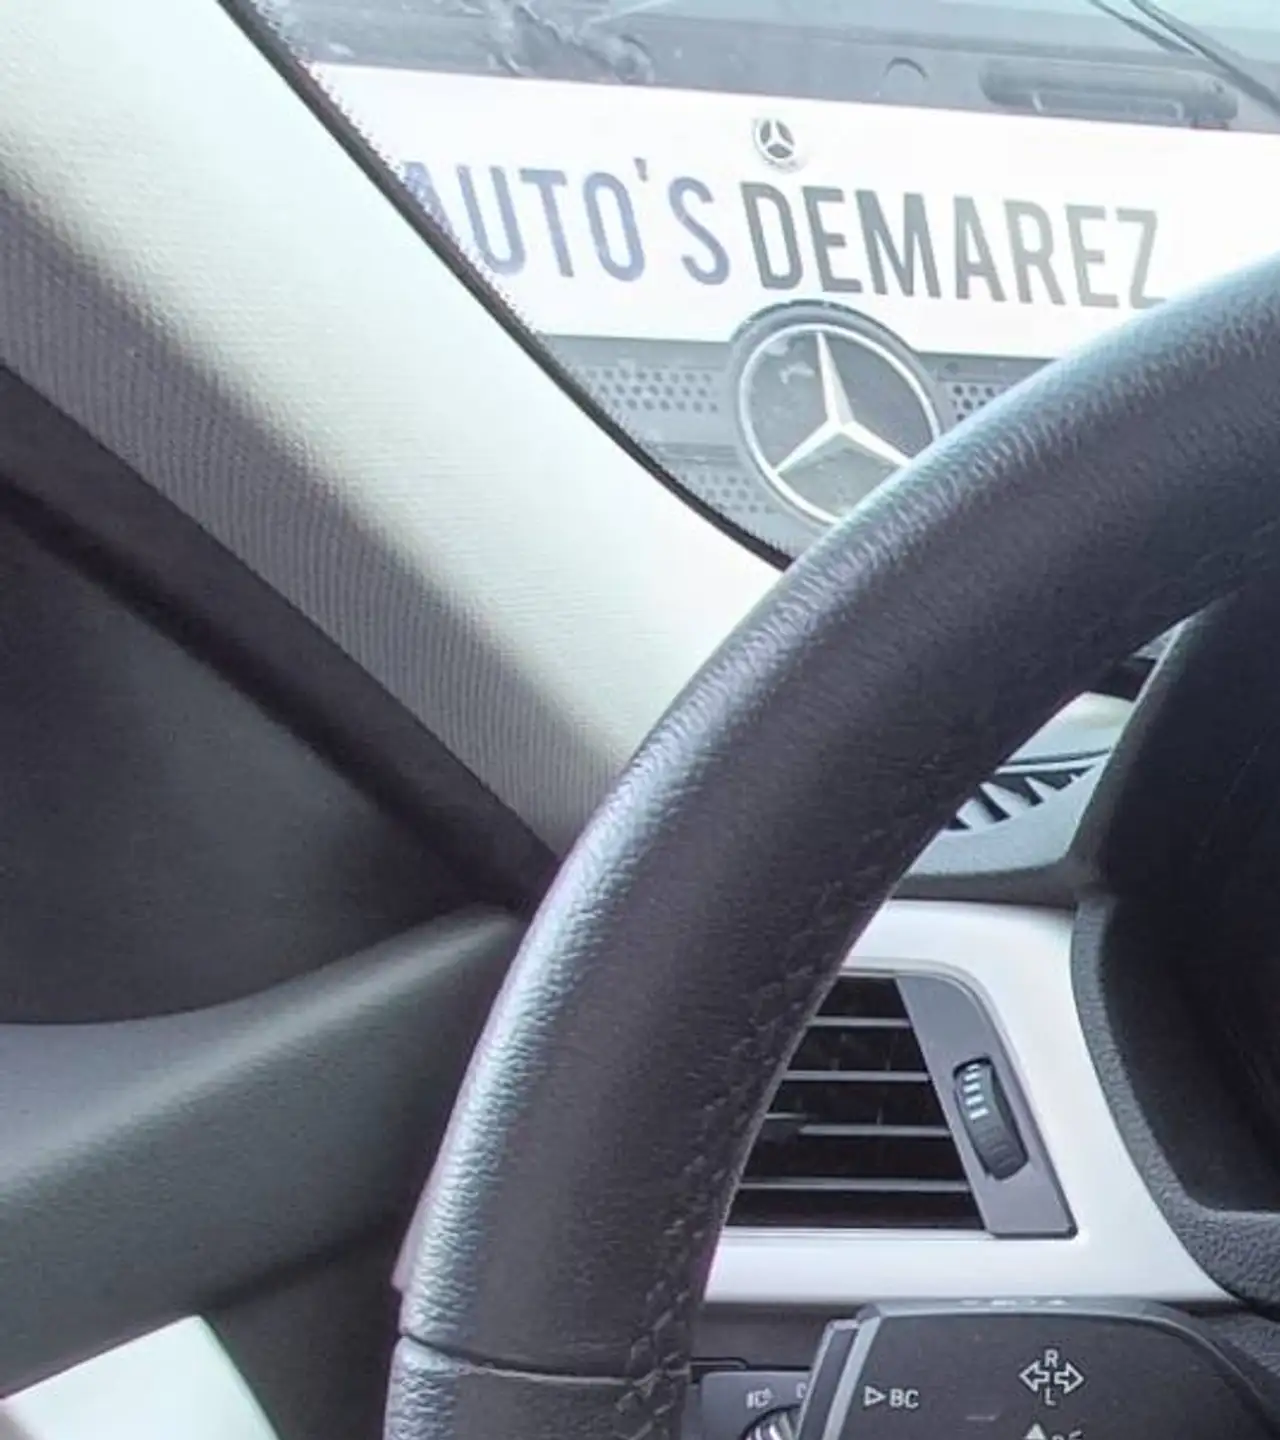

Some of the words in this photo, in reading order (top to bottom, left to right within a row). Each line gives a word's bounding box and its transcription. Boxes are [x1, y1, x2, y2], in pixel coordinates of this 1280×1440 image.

[740, 180, 1167, 311] DEMAREZ
[1044, 1349, 1058, 1368] R
[889, 1388, 919, 1409] BC
[1045, 1387, 1055, 1406] L
